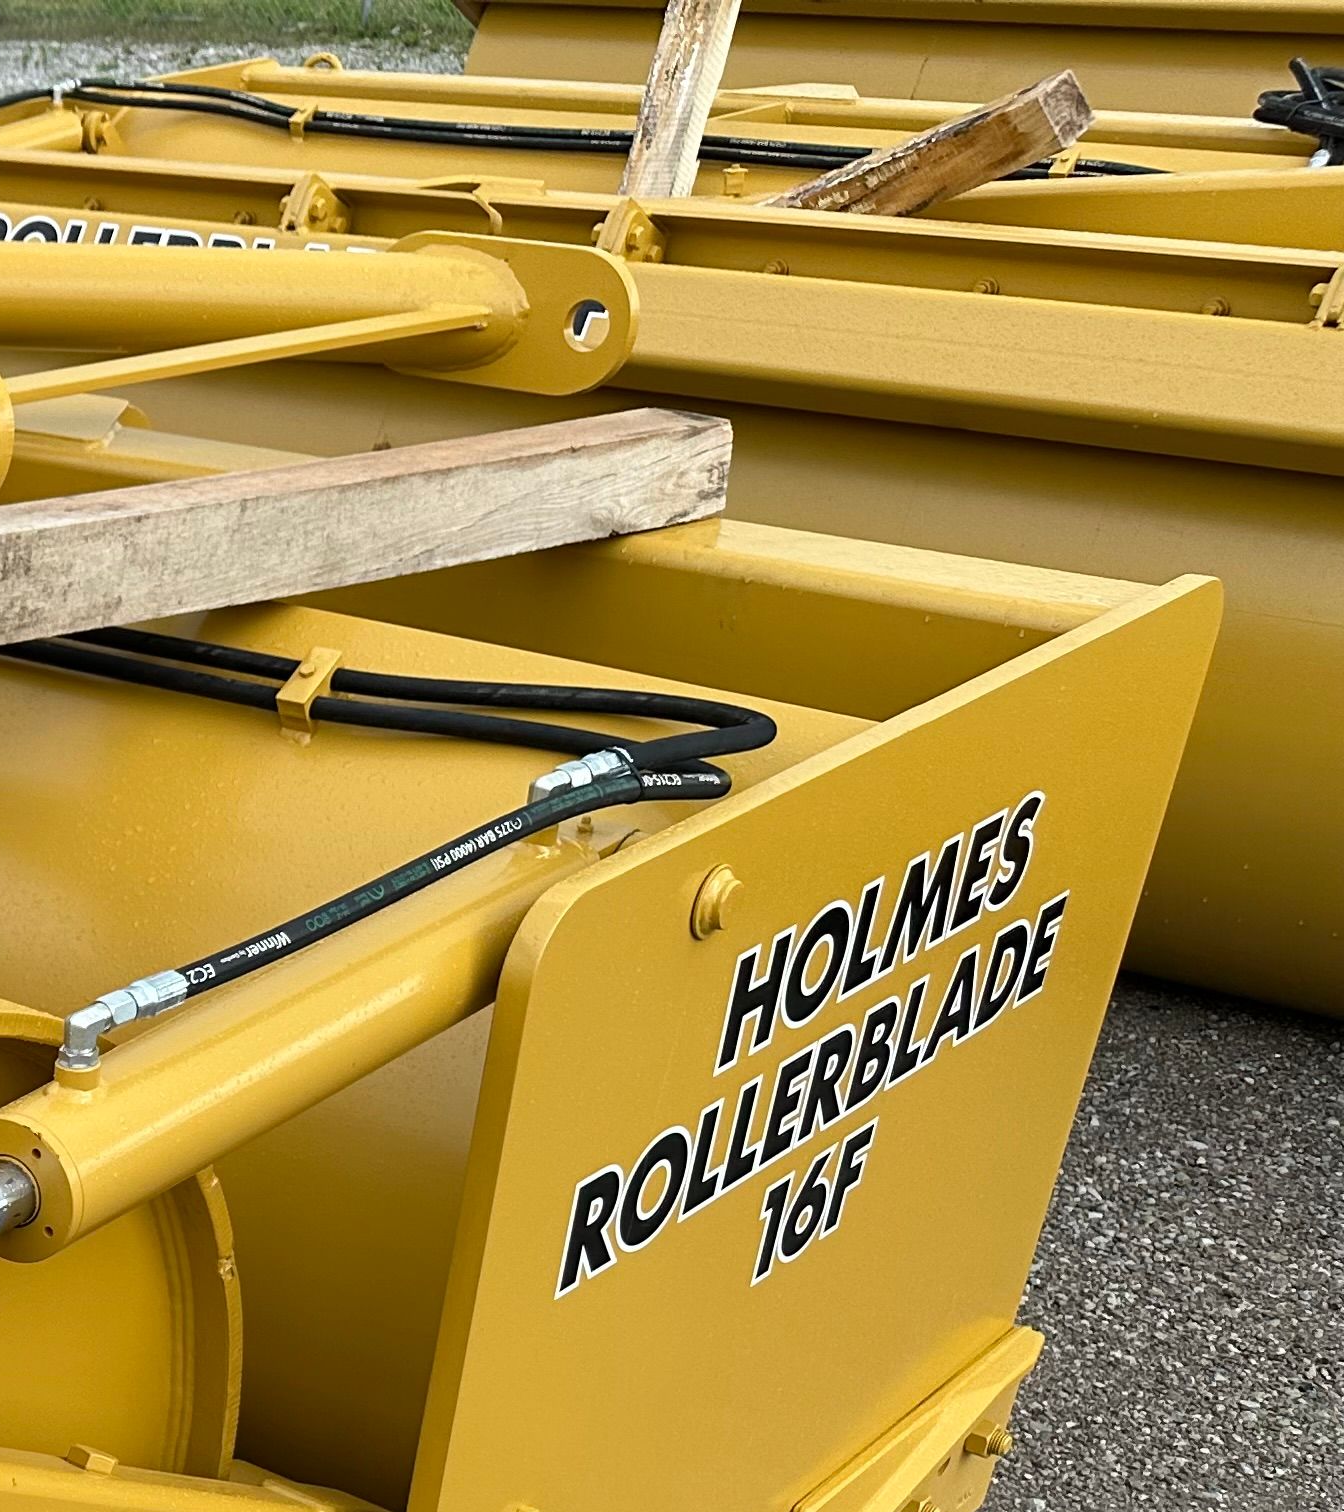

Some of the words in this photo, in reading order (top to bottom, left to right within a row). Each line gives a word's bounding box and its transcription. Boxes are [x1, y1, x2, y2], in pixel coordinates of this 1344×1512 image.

[476, 829, 496, 848] BAR
[184, 963, 216, 985] EC2
[245, 931, 292, 958] Winner
[713, 790, 1045, 1076] HOLMES
[554, 890, 1070, 1300] ROLLERBLADE
[750, 1115, 879, 1287] 16F
